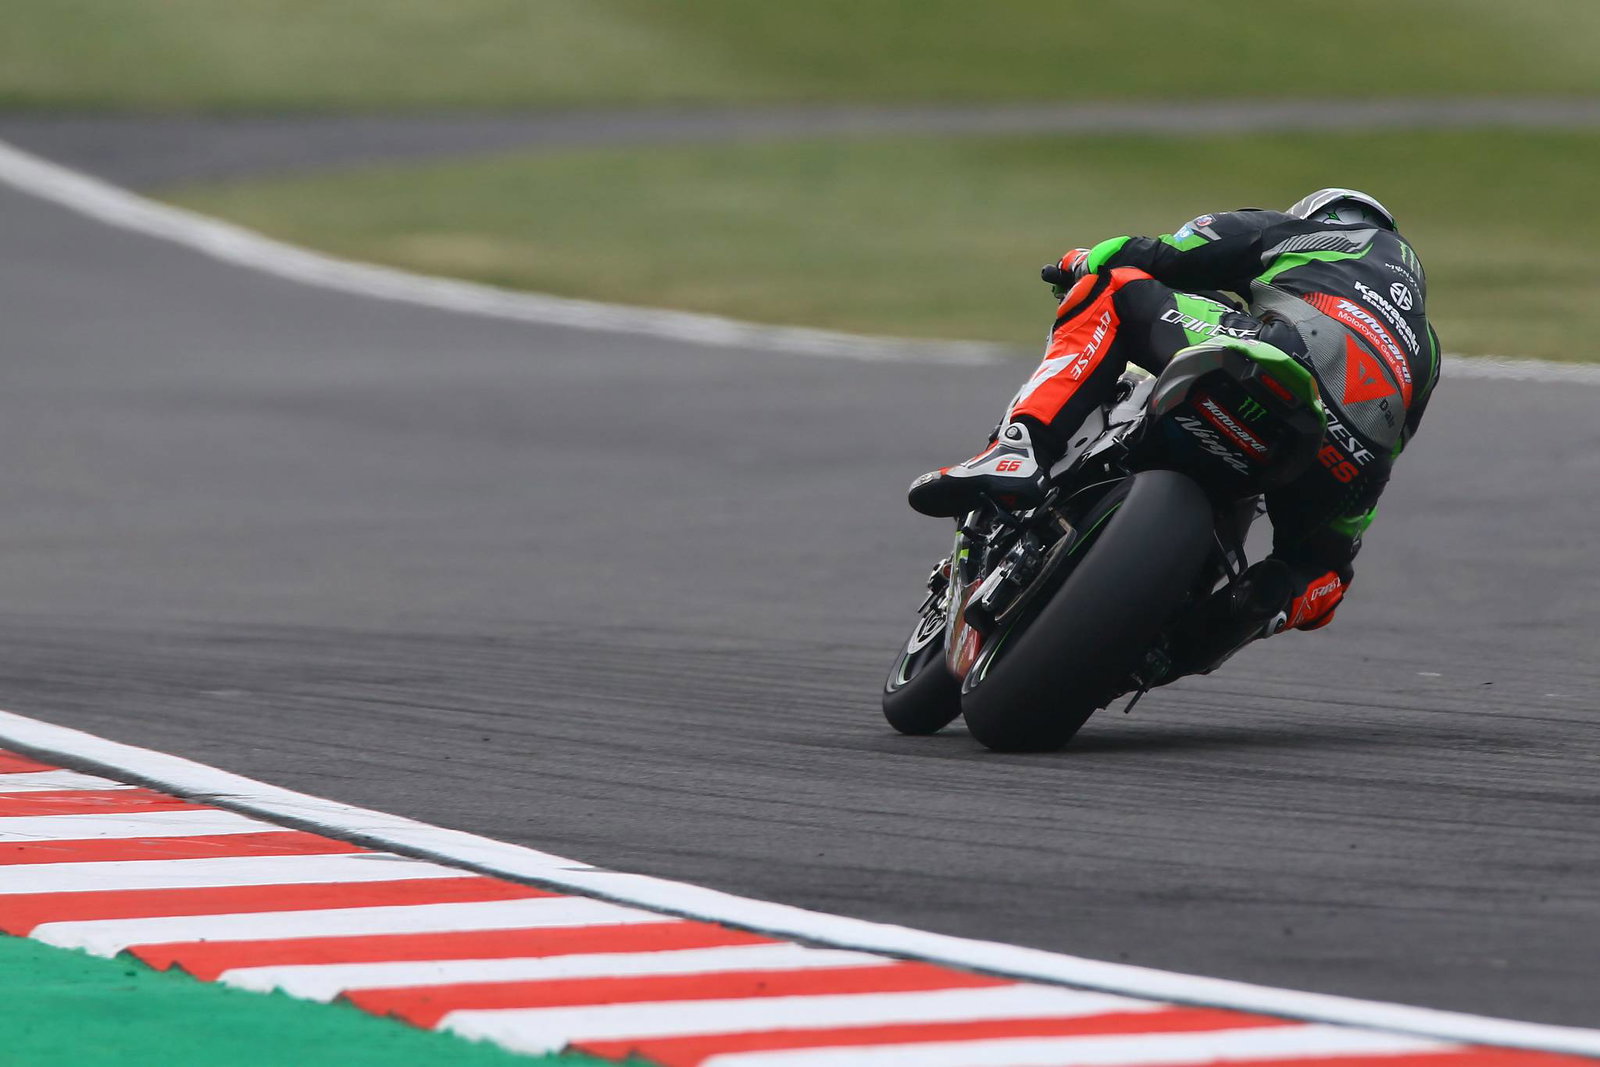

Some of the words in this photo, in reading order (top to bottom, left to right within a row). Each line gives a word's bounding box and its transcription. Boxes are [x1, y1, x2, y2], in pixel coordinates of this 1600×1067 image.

[1354, 281, 1420, 357] Kawasaki
[1362, 294, 1395, 325] Racing
[1070, 310, 1111, 380] DAINESE
[1337, 311, 1380, 345] Motorcycle
[996, 460, 1022, 471] 66
